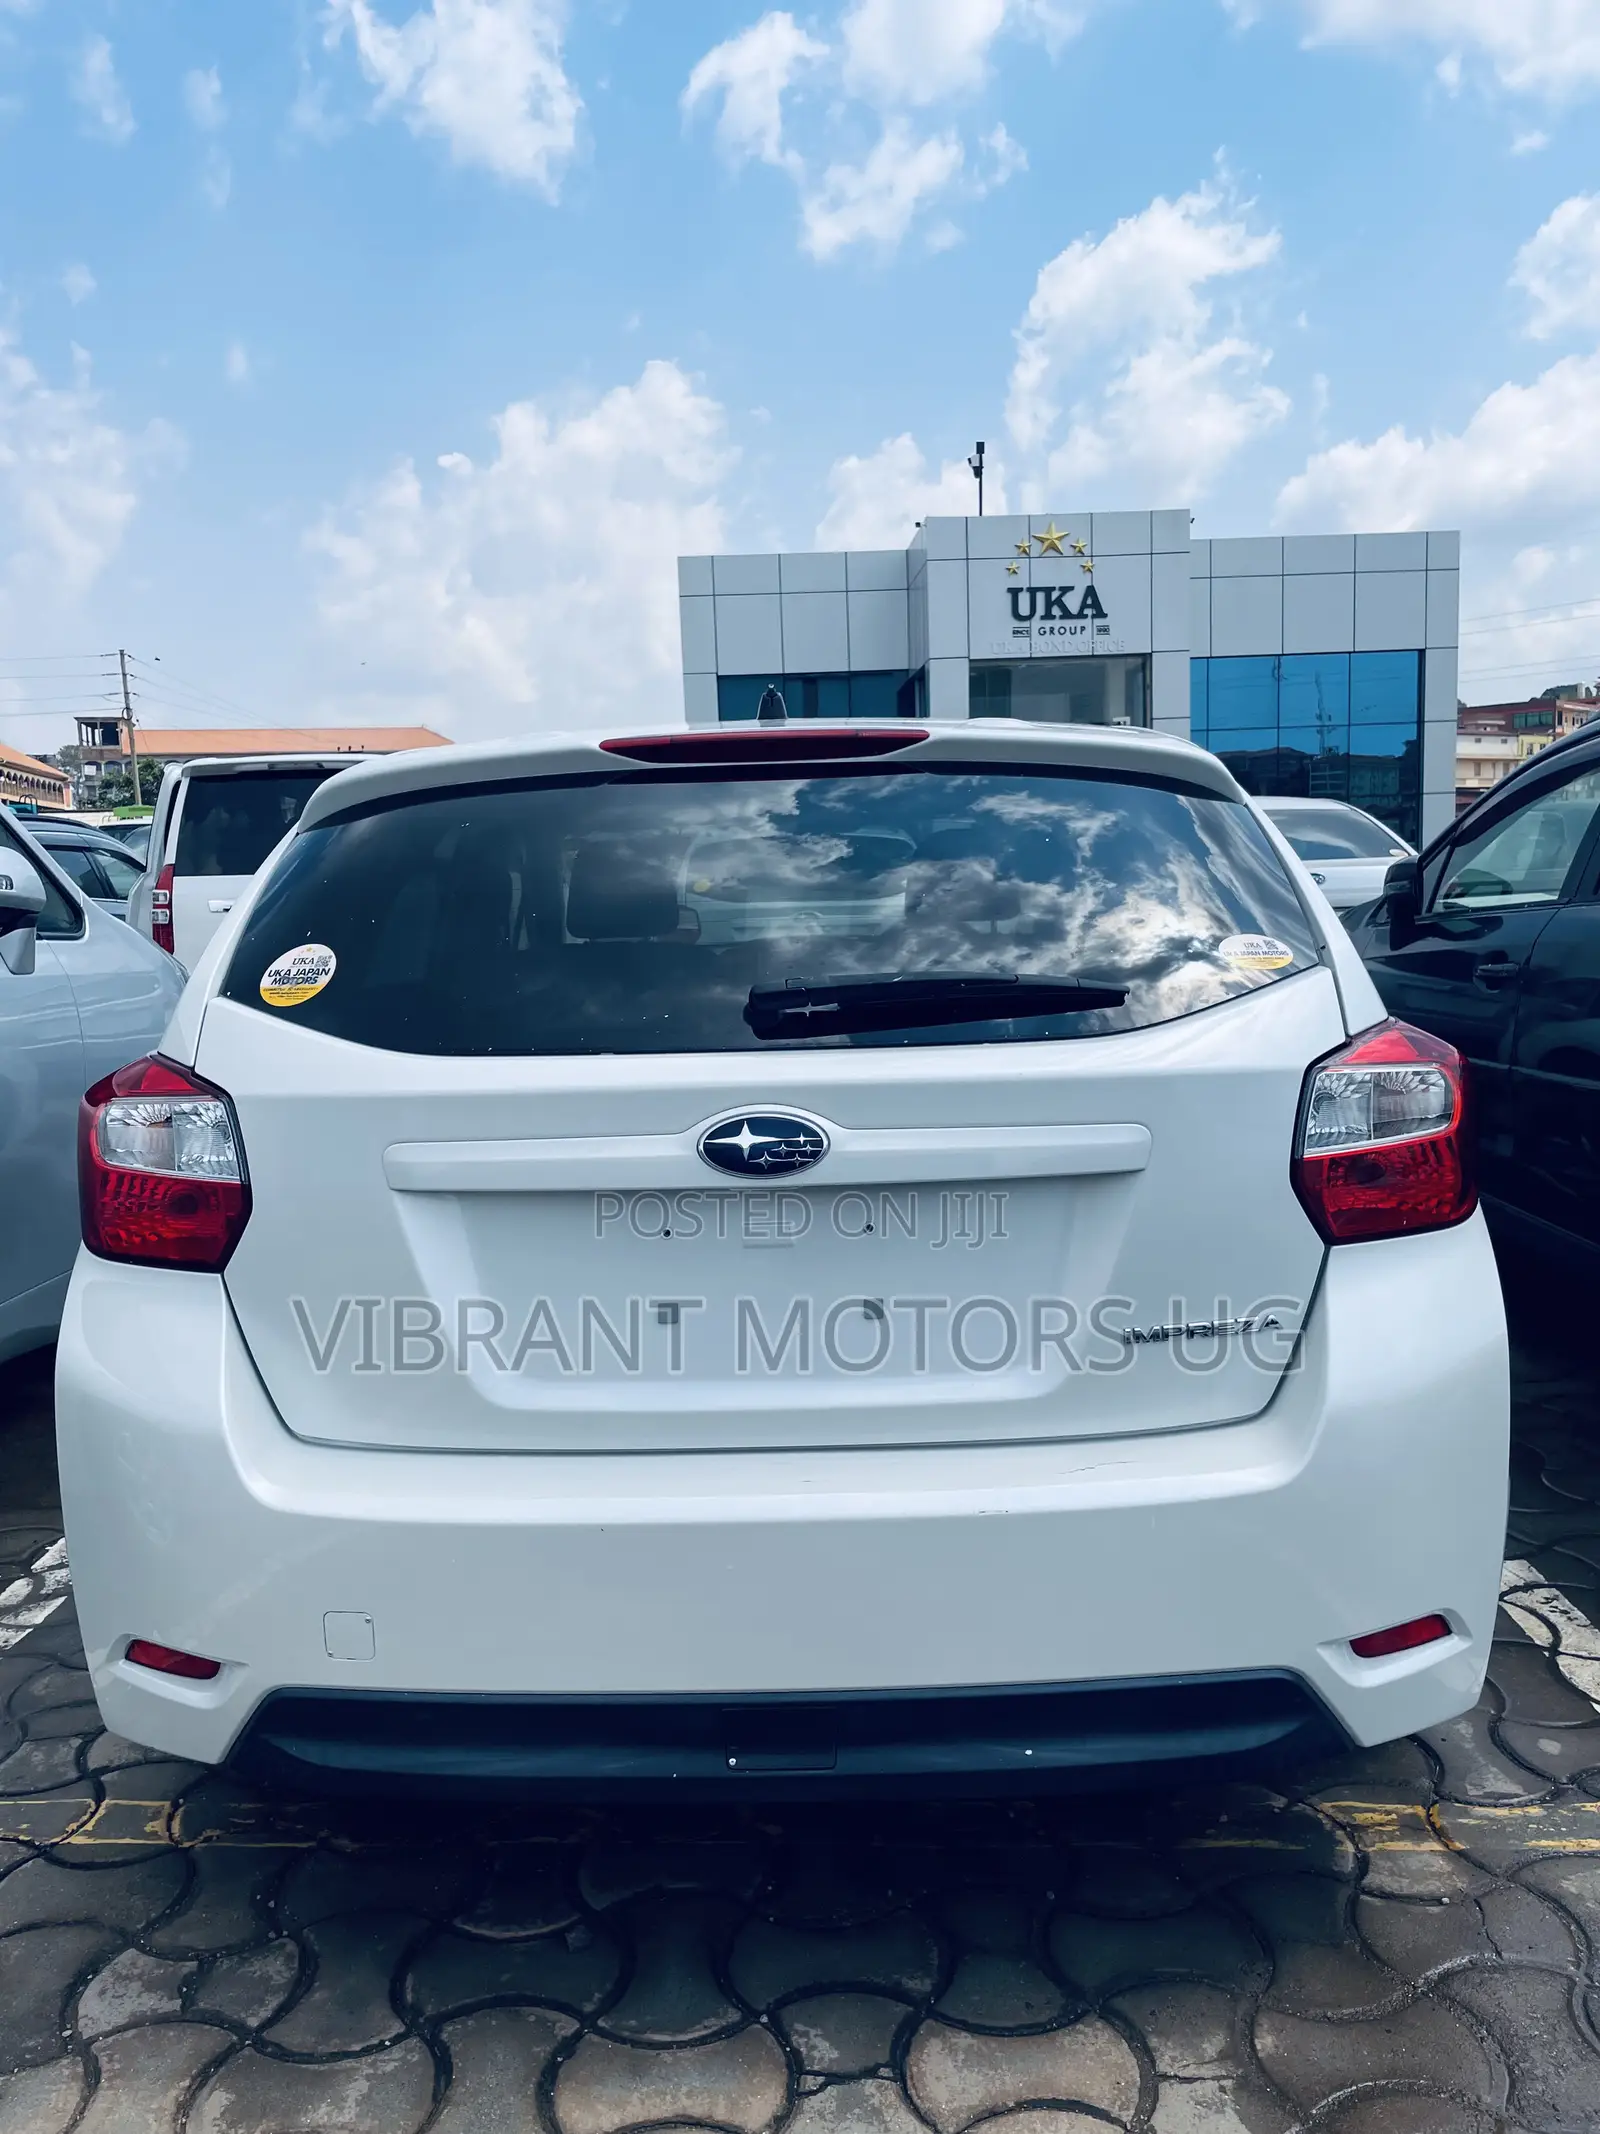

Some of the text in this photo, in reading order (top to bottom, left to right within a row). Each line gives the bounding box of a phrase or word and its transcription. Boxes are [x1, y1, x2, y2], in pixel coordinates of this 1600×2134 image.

[1006, 584, 1109, 622] UKA
[1038, 625, 1086, 637] GROUP
[292, 957, 315, 965] UKA
[267, 967, 331, 978] UKA JAPAN
[270, 976, 319, 986] MOTORS
[1122, 1313, 1285, 1345] IMPREZA
